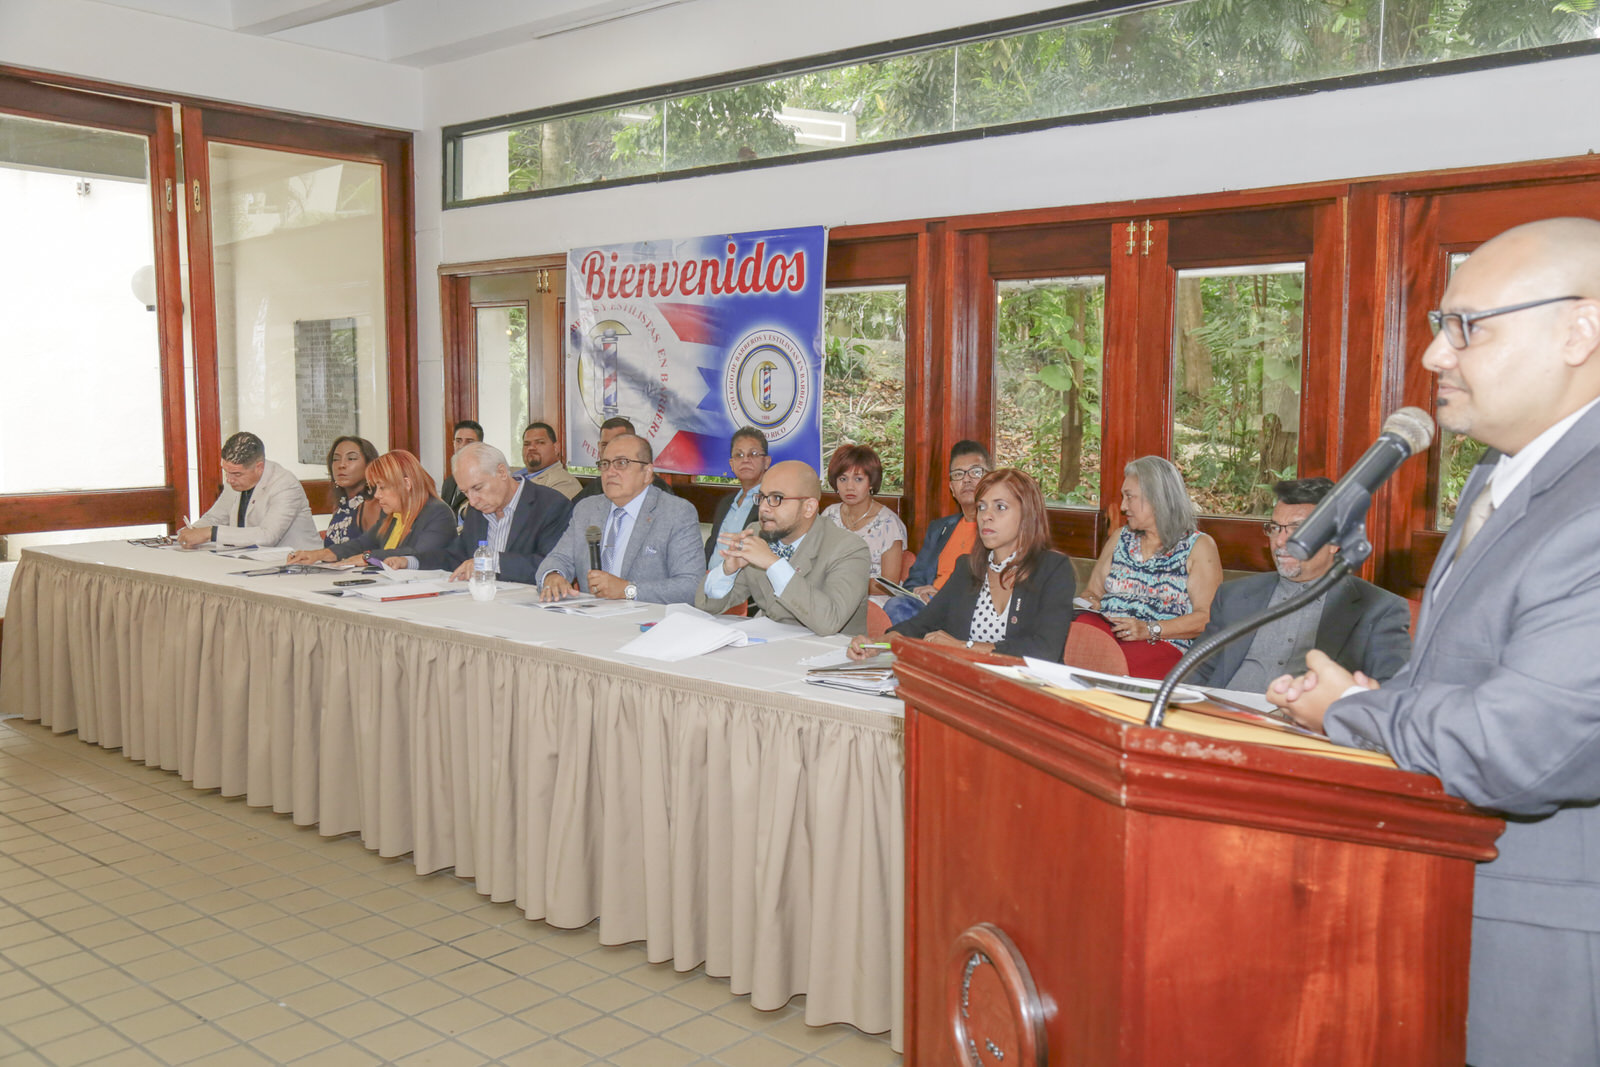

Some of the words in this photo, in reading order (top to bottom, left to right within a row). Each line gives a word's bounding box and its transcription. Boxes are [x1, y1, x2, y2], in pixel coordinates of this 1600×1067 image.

[581, 241, 805, 300] Bienvenidos
[610, 303, 660, 343] ESTILISTAS
[657, 348, 668, 367] EN
[736, 336, 762, 362] BARBEROS
[768, 335, 799, 361] ESTILISTAS
[645, 373, 668, 441] BARBERI
